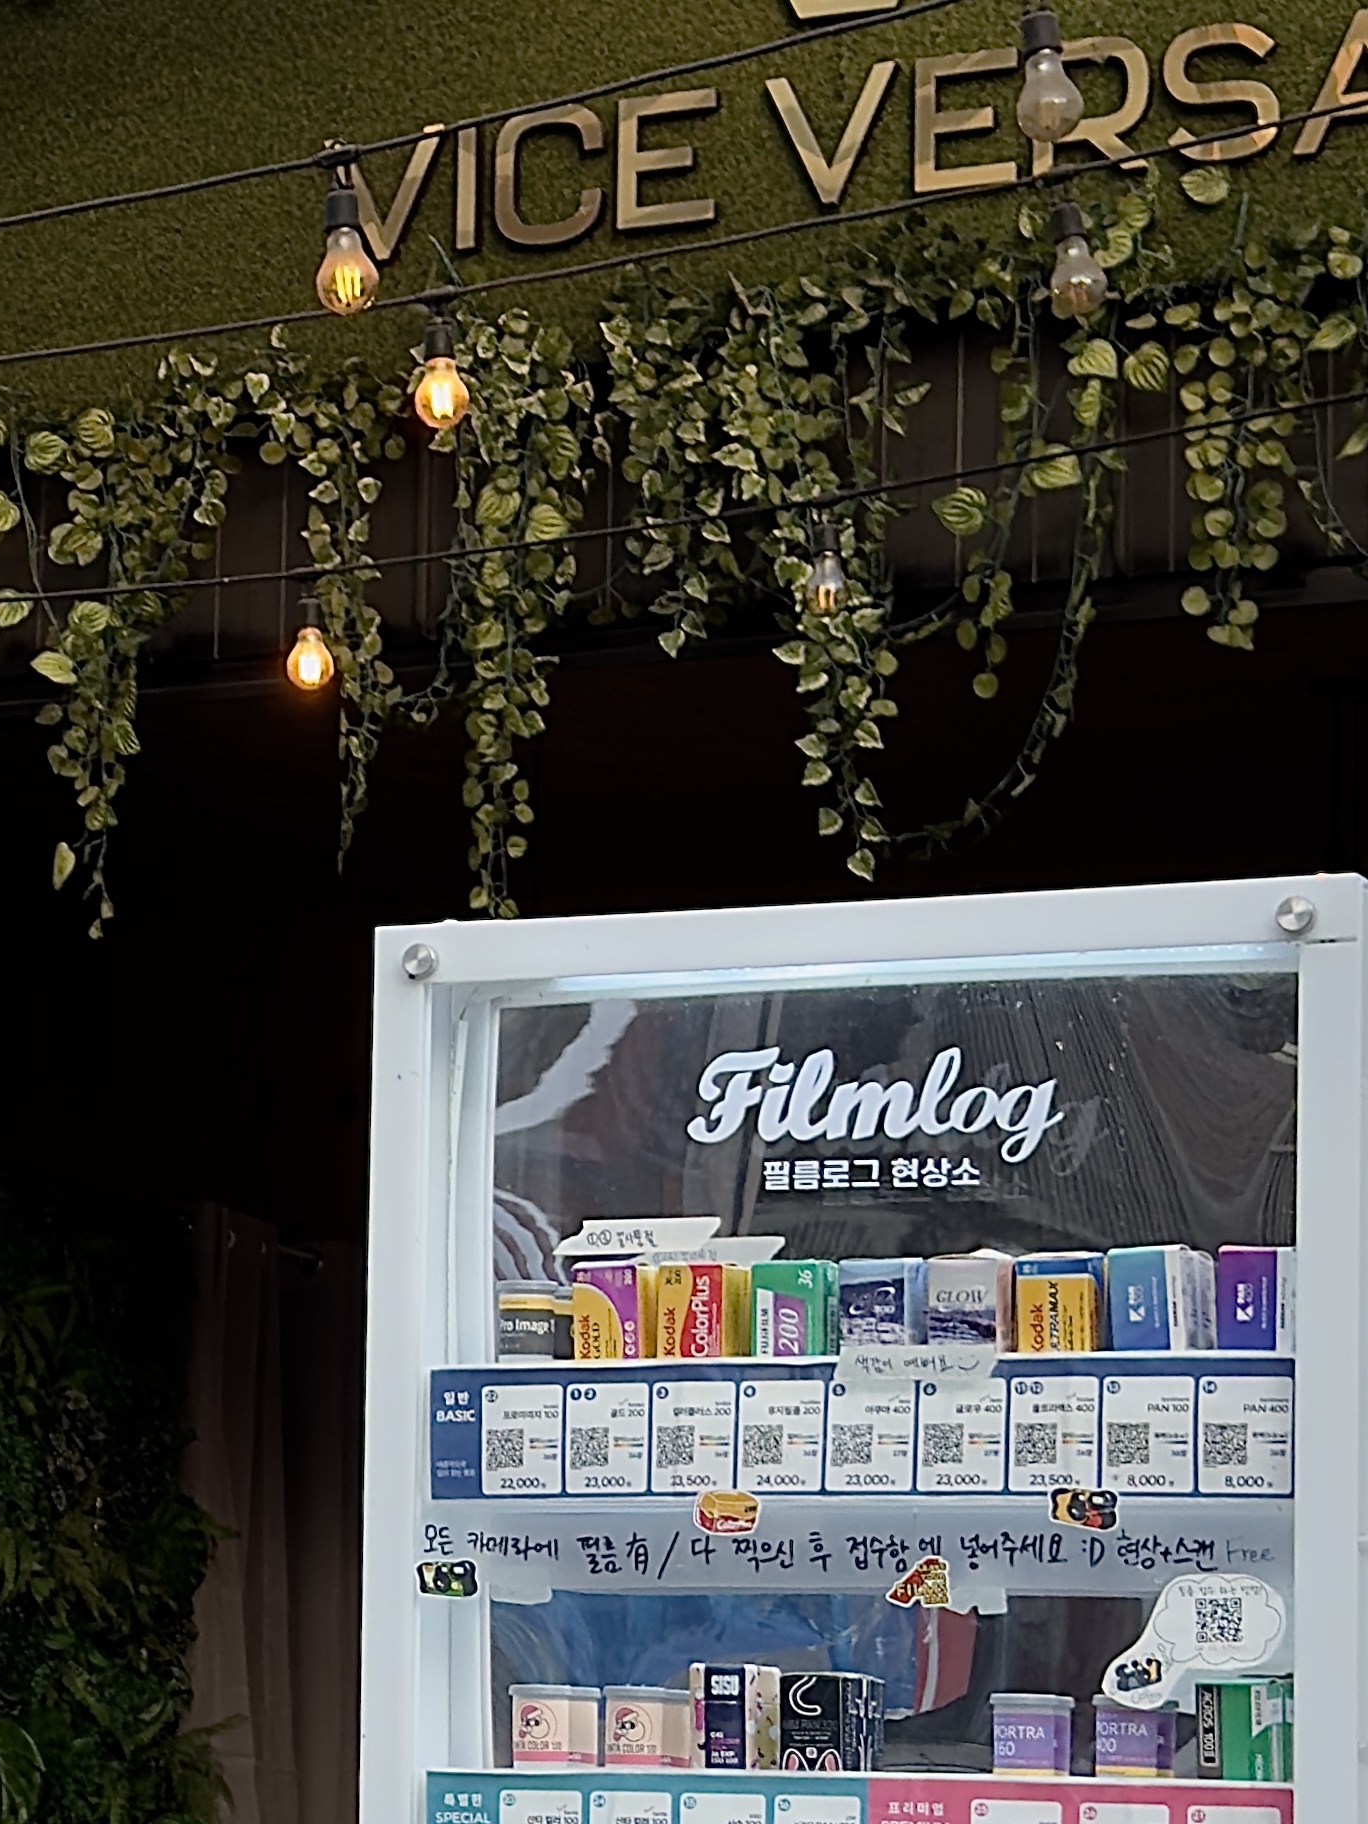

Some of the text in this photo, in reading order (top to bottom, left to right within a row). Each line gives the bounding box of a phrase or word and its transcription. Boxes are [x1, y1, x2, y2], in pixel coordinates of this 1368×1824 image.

[349, 88, 717, 261] VICE
[687, 1045, 1062, 1162] Filmlog
[762, 1158, 981, 1191] 필름로그 현상소
[799, 1269, 814, 1288] 36
[936, 1290, 988, 1303] GLOW
[691, 1275, 711, 1357] ColorPlus
[516, 1319, 549, 1335] Image
[663, 1307, 676, 1357] Kodak
[779, 1308, 799, 1355] 200
[580, 1314, 590, 1359] Kodak
[544, 1411, 559, 1419] 100
[628, 1409, 644, 1417] 200
[715, 1407, 731, 1416] 200
[803, 1406, 820, 1414] 200
[893, 1406, 911, 1414] 400
[984, 1405, 1002, 1413] 400
[1147, 1404, 1189, 1413] PAN 100
[1243, 1404, 1289, 1413] PAN 400
[436, 1410, 476, 1422] BASIC
[423, 1524, 454, 1556] 모든
[467, 1530, 559, 1561] 카메라에
[691, 1537, 716, 1565] 다
[731, 1538, 795, 1573] 찍으신
[808, 1531, 833, 1571] 후
[845, 1535, 910, 1572] 접수함
[960, 1534, 1067, 1570] 넣어주세요
[1081, 1535, 1106, 1568] :D
[1226, 1540, 1277, 1563] Free
[711, 1675, 739, 1696] SISU
[528, 1739, 550, 1751] COLOR
[623, 1742, 646, 1754] COLOR
[444, 1793, 482, 1807] 특별한
[888, 1801, 944, 1816] 프리미엄
[435, 1812, 491, 1824] SPECIAL
[527, 1816, 578, 1824] 산타 컬러 100
